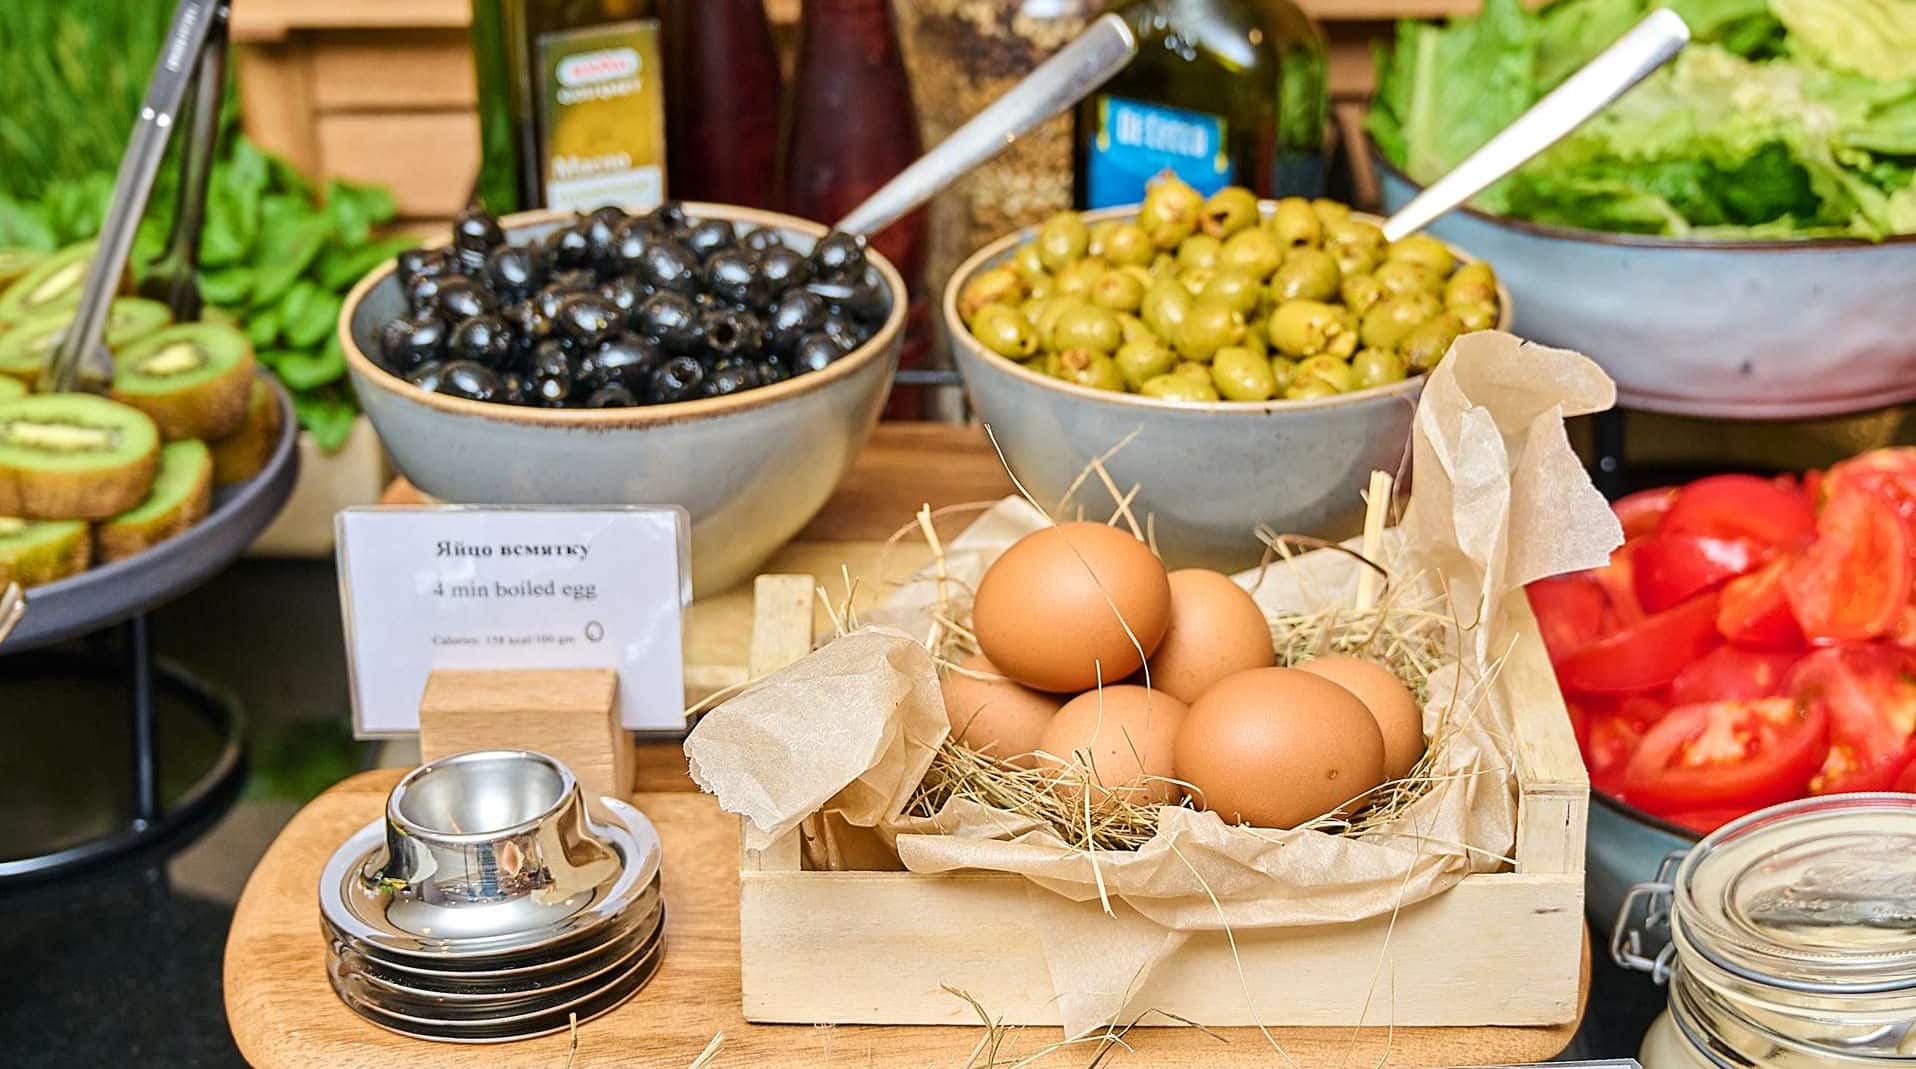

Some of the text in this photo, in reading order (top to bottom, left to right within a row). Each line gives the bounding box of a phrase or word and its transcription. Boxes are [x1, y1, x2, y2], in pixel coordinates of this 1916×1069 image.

[437, 540, 591, 561] Яйцо всмятку
[433, 579, 598, 601] 4 min boiled egg
